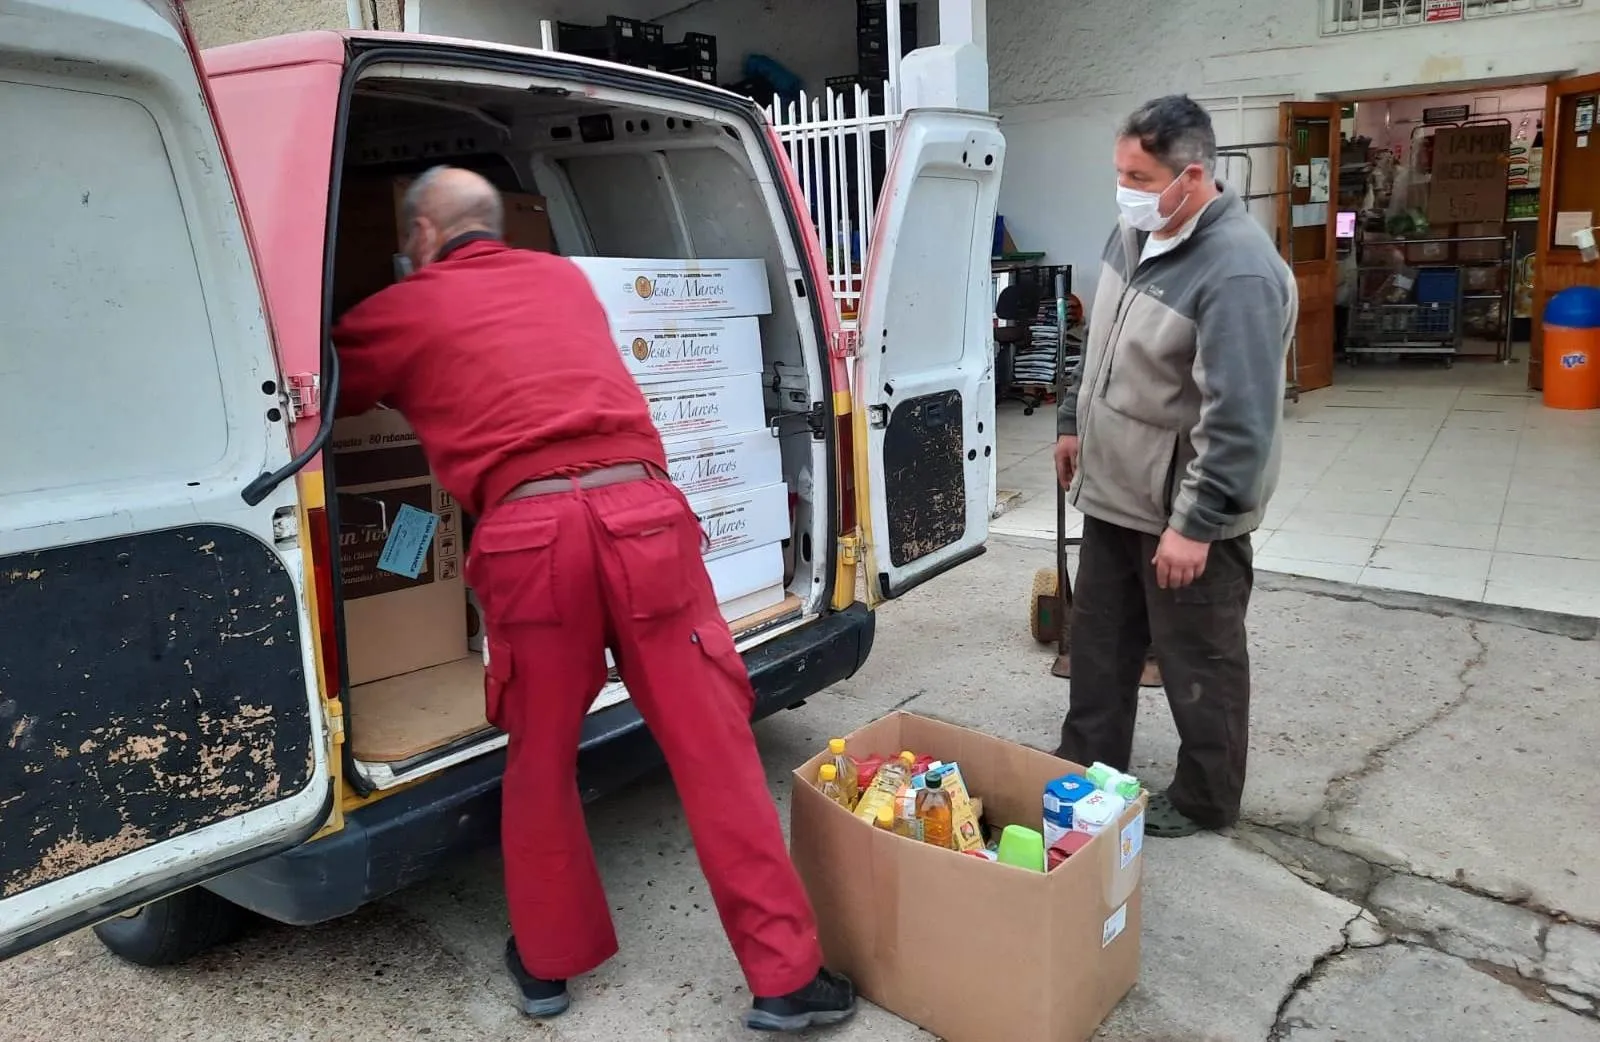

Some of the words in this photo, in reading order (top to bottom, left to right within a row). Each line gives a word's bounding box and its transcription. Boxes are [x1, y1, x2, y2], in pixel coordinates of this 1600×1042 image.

[643, 279, 675, 300] Jesús
[681, 279, 724, 298] Marcos
[640, 339, 672, 363] Jesús
[676, 339, 719, 359] Marcos
[673, 400, 719, 421] Marcos
[691, 459, 737, 482] Marcos
